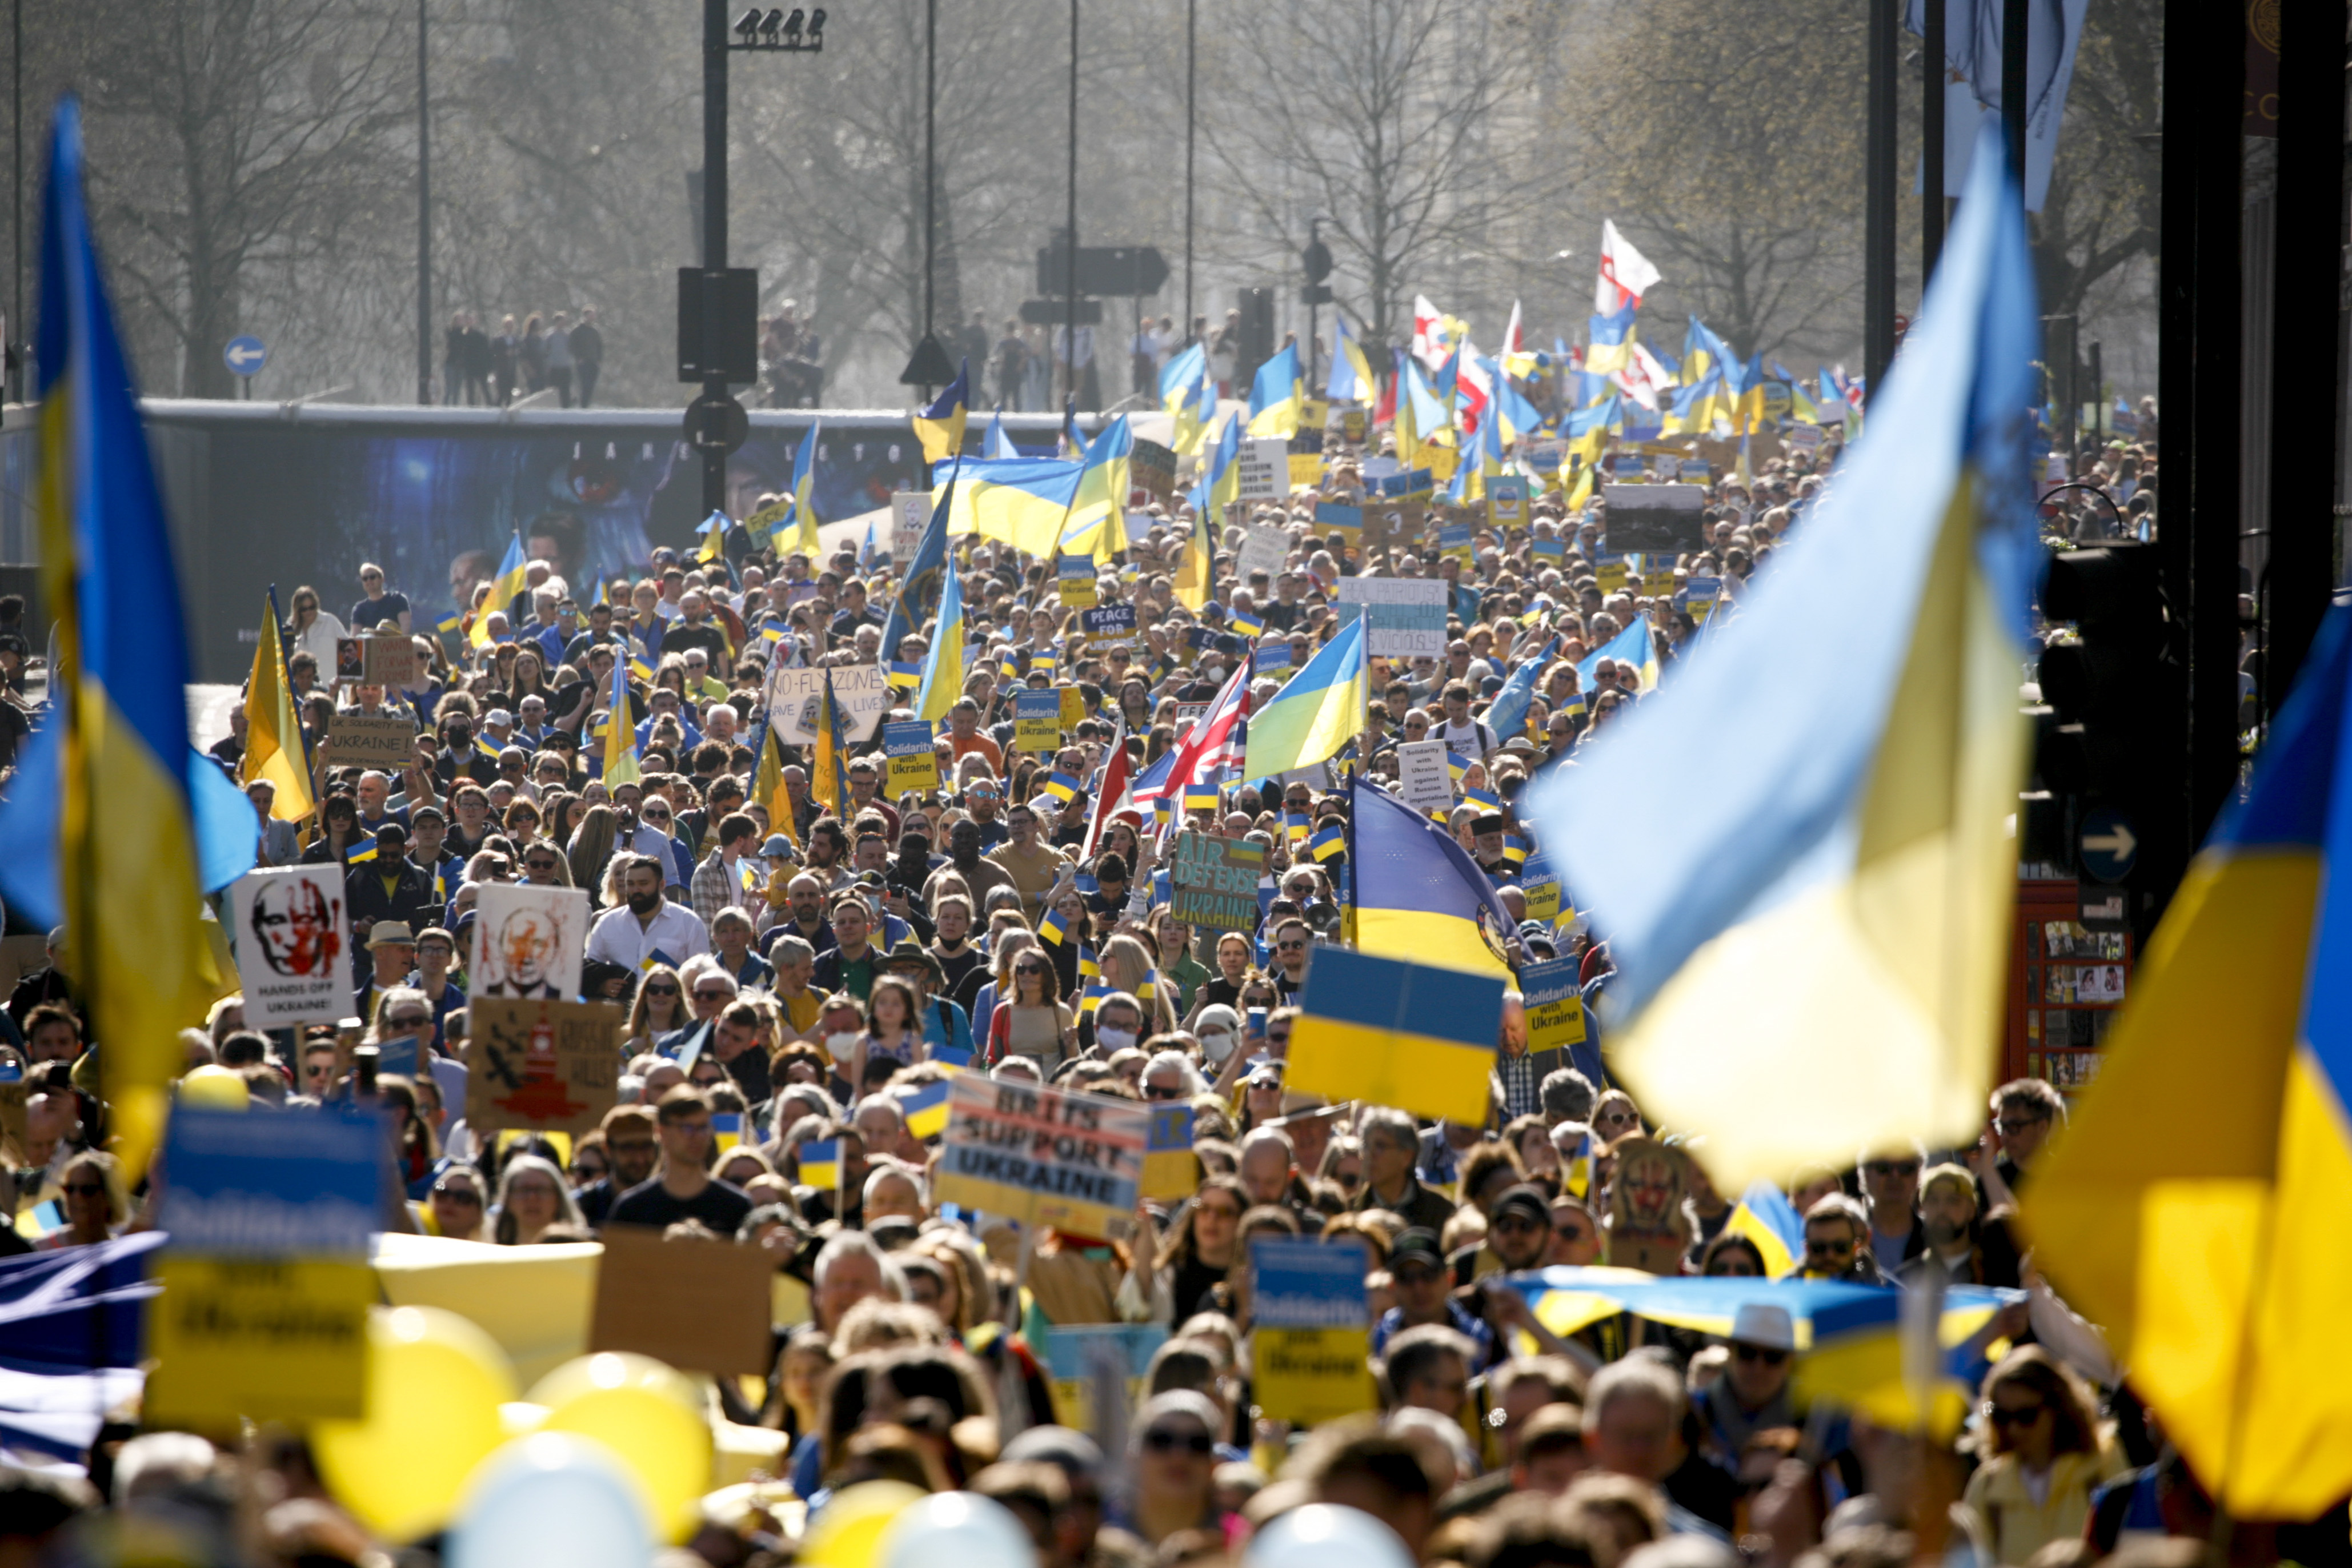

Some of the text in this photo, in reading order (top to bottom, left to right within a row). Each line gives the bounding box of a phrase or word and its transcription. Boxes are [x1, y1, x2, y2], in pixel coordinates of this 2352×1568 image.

[1058, 568, 1095, 580] Solidarity
[1091, 608, 1129, 624] PEACE
[1099, 623, 1124, 636] FOR
[1257, 660, 1291, 671] Solidarity
[834, 668, 884, 690] ZONE
[854, 696, 885, 712] LIVES
[1017, 707, 1059, 718] Solidarity
[331, 719, 344, 728] UK
[348, 719, 393, 729] SOLIDARITY
[1020, 725, 1056, 736] Ukraine
[887, 742, 933, 755] Solidarity
[1406, 747, 1439, 756] Solidarity
[899, 754, 917, 763] with
[892, 762, 932, 775] Ukraine
[1414, 776, 1439, 784] against
[1409, 794, 1449, 803] imperialism
[1175, 861, 1261, 895] DEFENSE
[1521, 871, 1561, 888] Solidarity
[1529, 885, 1545, 895] with
[259, 984, 306, 997] HANDS
[309, 980, 333, 994] OFF
[1525, 983, 1578, 1006] Solidarity
[267, 998, 331, 1013] UKRAINE!
[1539, 1001, 1561, 1014] with
[1532, 1009, 1578, 1030] Ukraine
[996, 1084, 1100, 1130] BRITS
[965, 1116, 1123, 1170] SUPPORT
[958, 1148, 1118, 1202] UKRAINE
